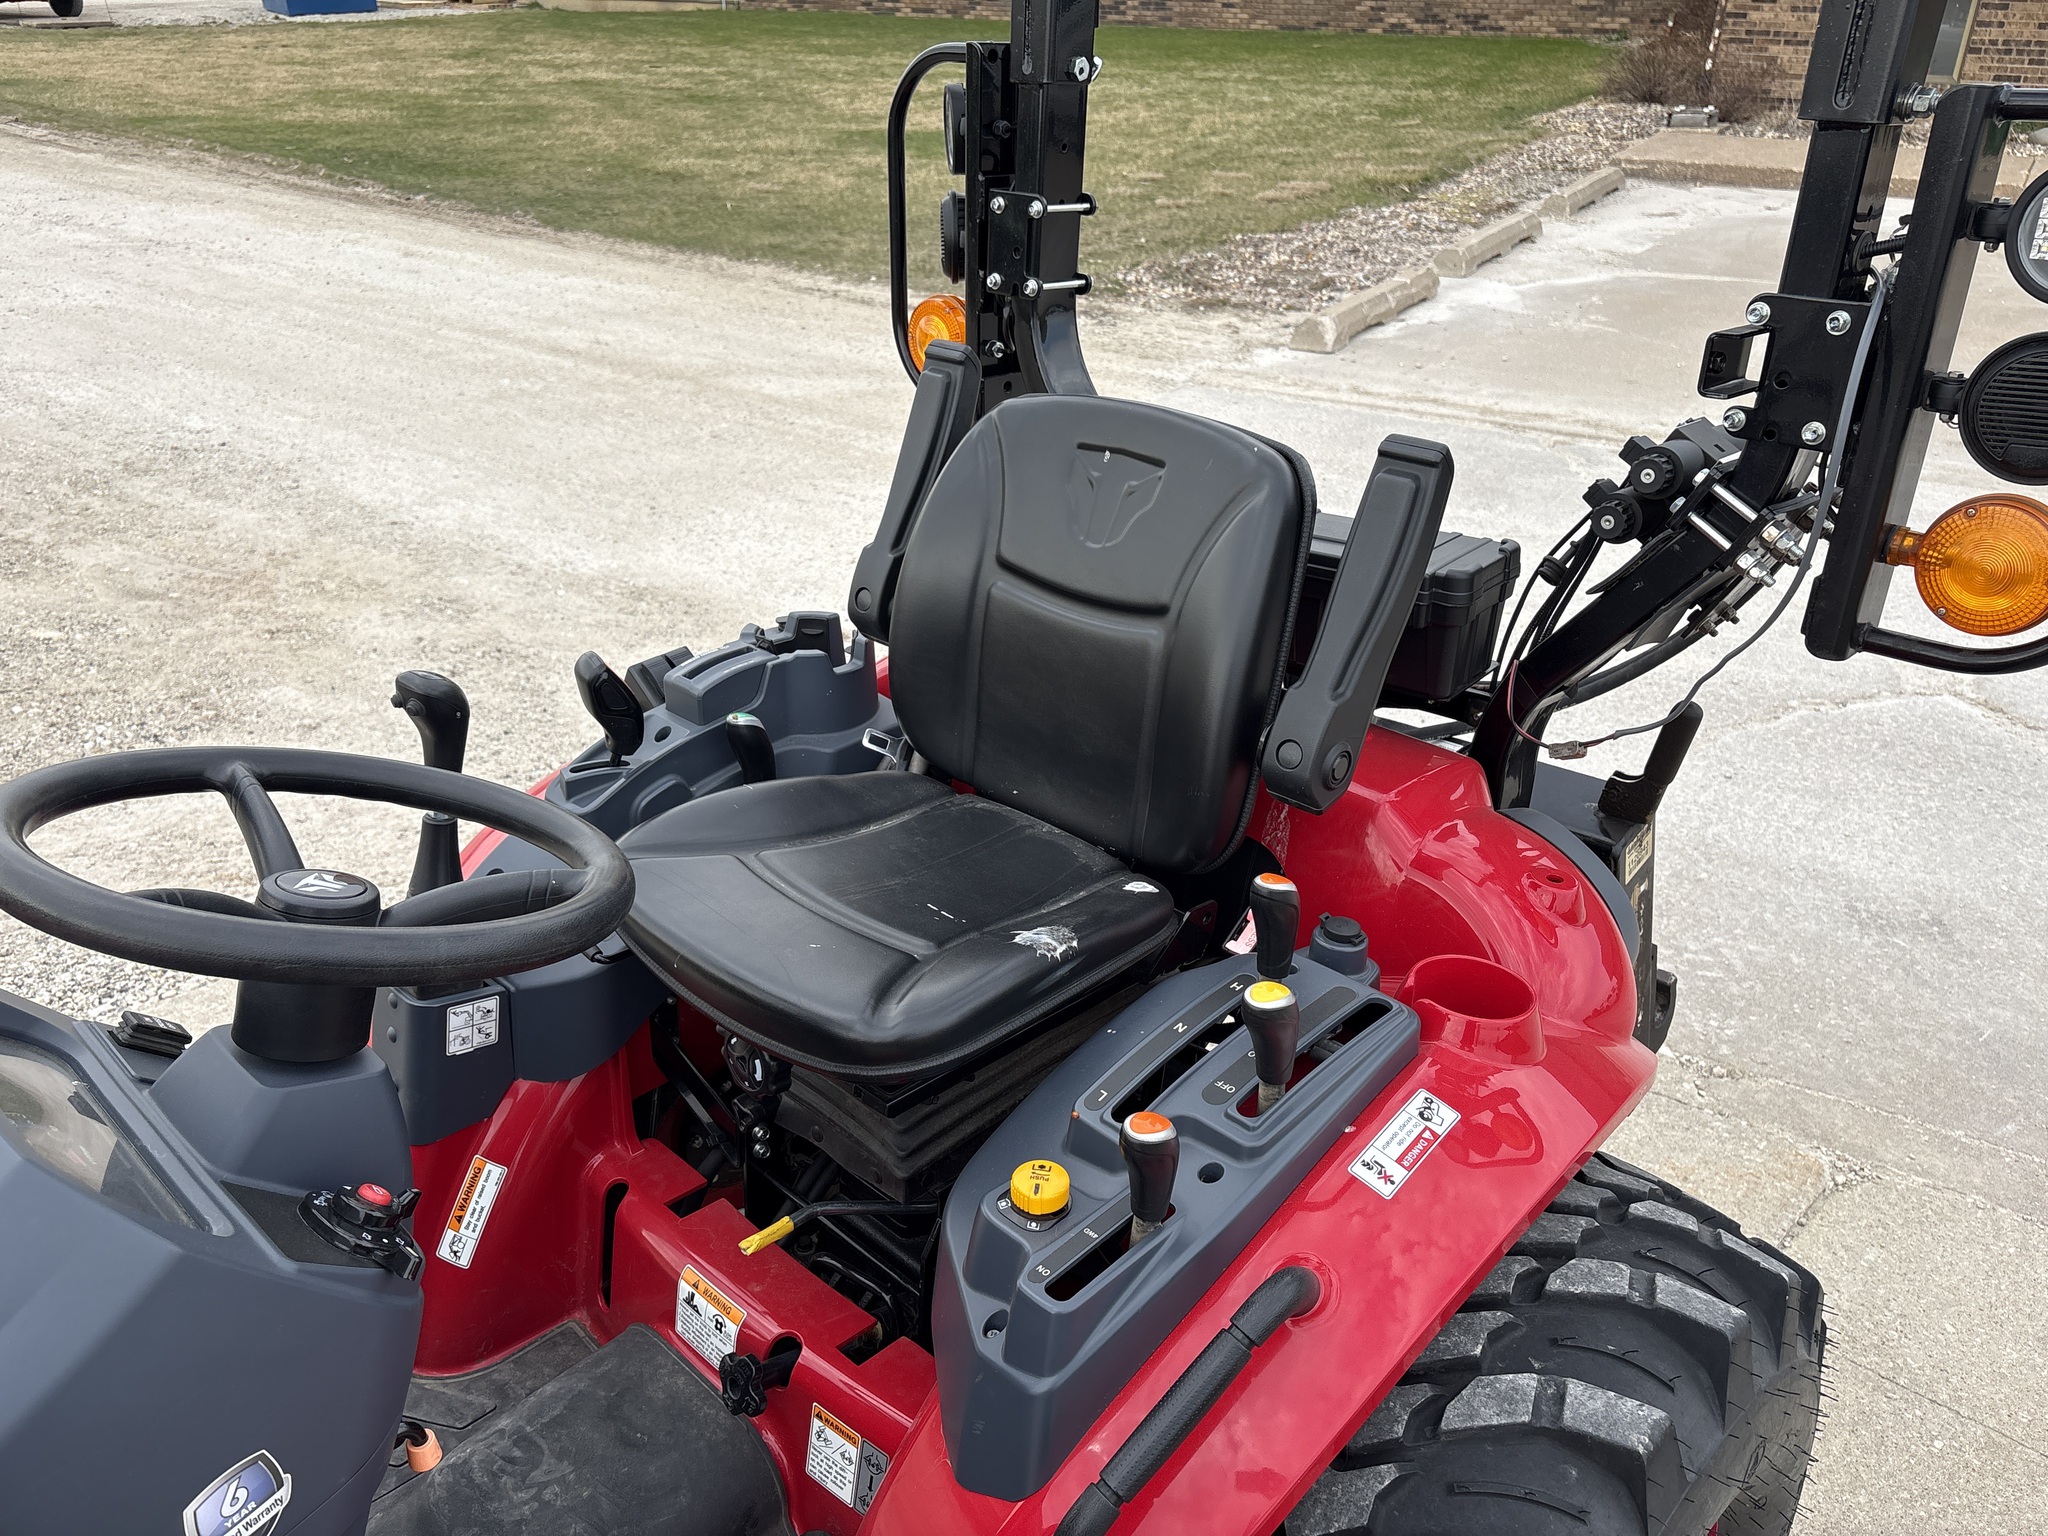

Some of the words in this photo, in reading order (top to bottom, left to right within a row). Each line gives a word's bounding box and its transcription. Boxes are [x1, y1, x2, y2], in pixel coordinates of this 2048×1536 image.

[1229, 981, 1244, 992] H
[1173, 1022, 1188, 1033] N
[1214, 1080, 1236, 1094] OFF
[1098, 1089, 1108, 1102] L
[1399, 1116, 1413, 1133] except
[1412, 1121, 1422, 1129] Do
[1405, 1129, 1414, 1138] not
[1381, 1131, 1399, 1151] operator
[1397, 1136, 1406, 1147] ride
[1401, 1138, 1428, 1168] DANGER
[1029, 1175, 1050, 1183] PUSH
[457, 1166, 481, 1212] WARNING
[1083, 1227, 1099, 1239] 4WD
[1035, 1264, 1051, 1277] ON
[702, 1286, 732, 1315] WARNING
[824, 1416, 857, 1445] WARNING
[220, 1477, 249, 1518] 6
[224, 1500, 257, 1528] YEAR
[241, 1495, 284, 1532] Warranty
